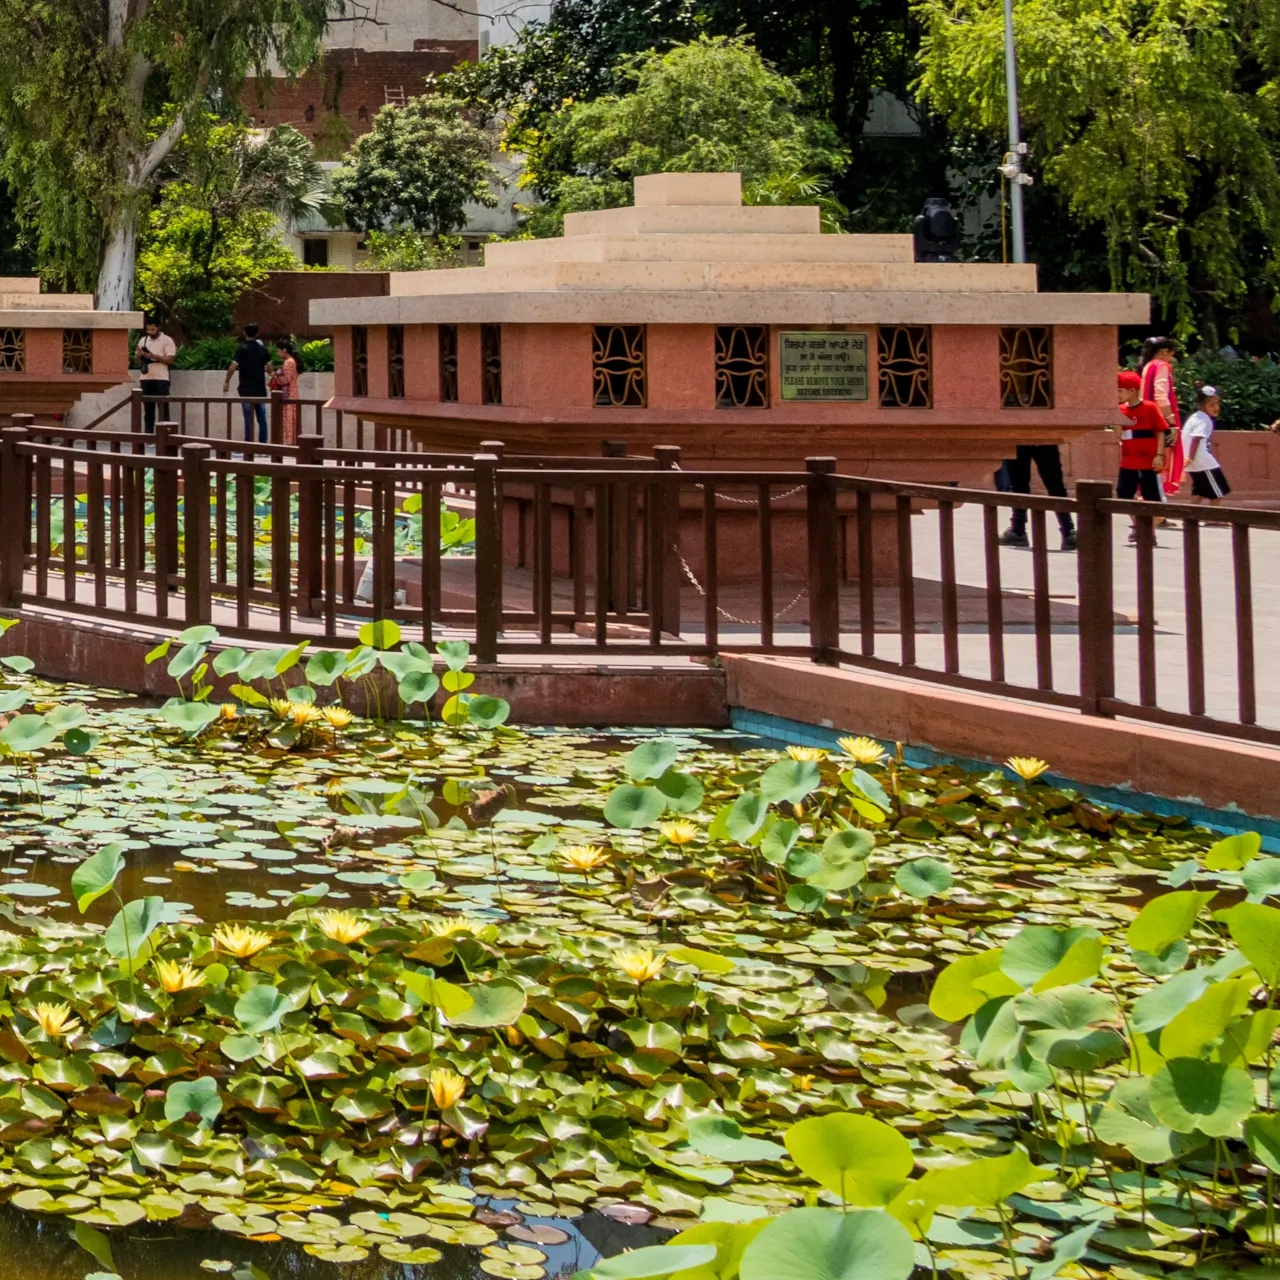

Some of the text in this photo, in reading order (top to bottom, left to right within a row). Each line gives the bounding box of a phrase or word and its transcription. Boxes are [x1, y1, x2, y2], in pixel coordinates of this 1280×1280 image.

[784, 376, 865, 386] PLEASE REMOVE YOUR SHOES
[796, 388, 853, 396] BEFORE ENTERING
